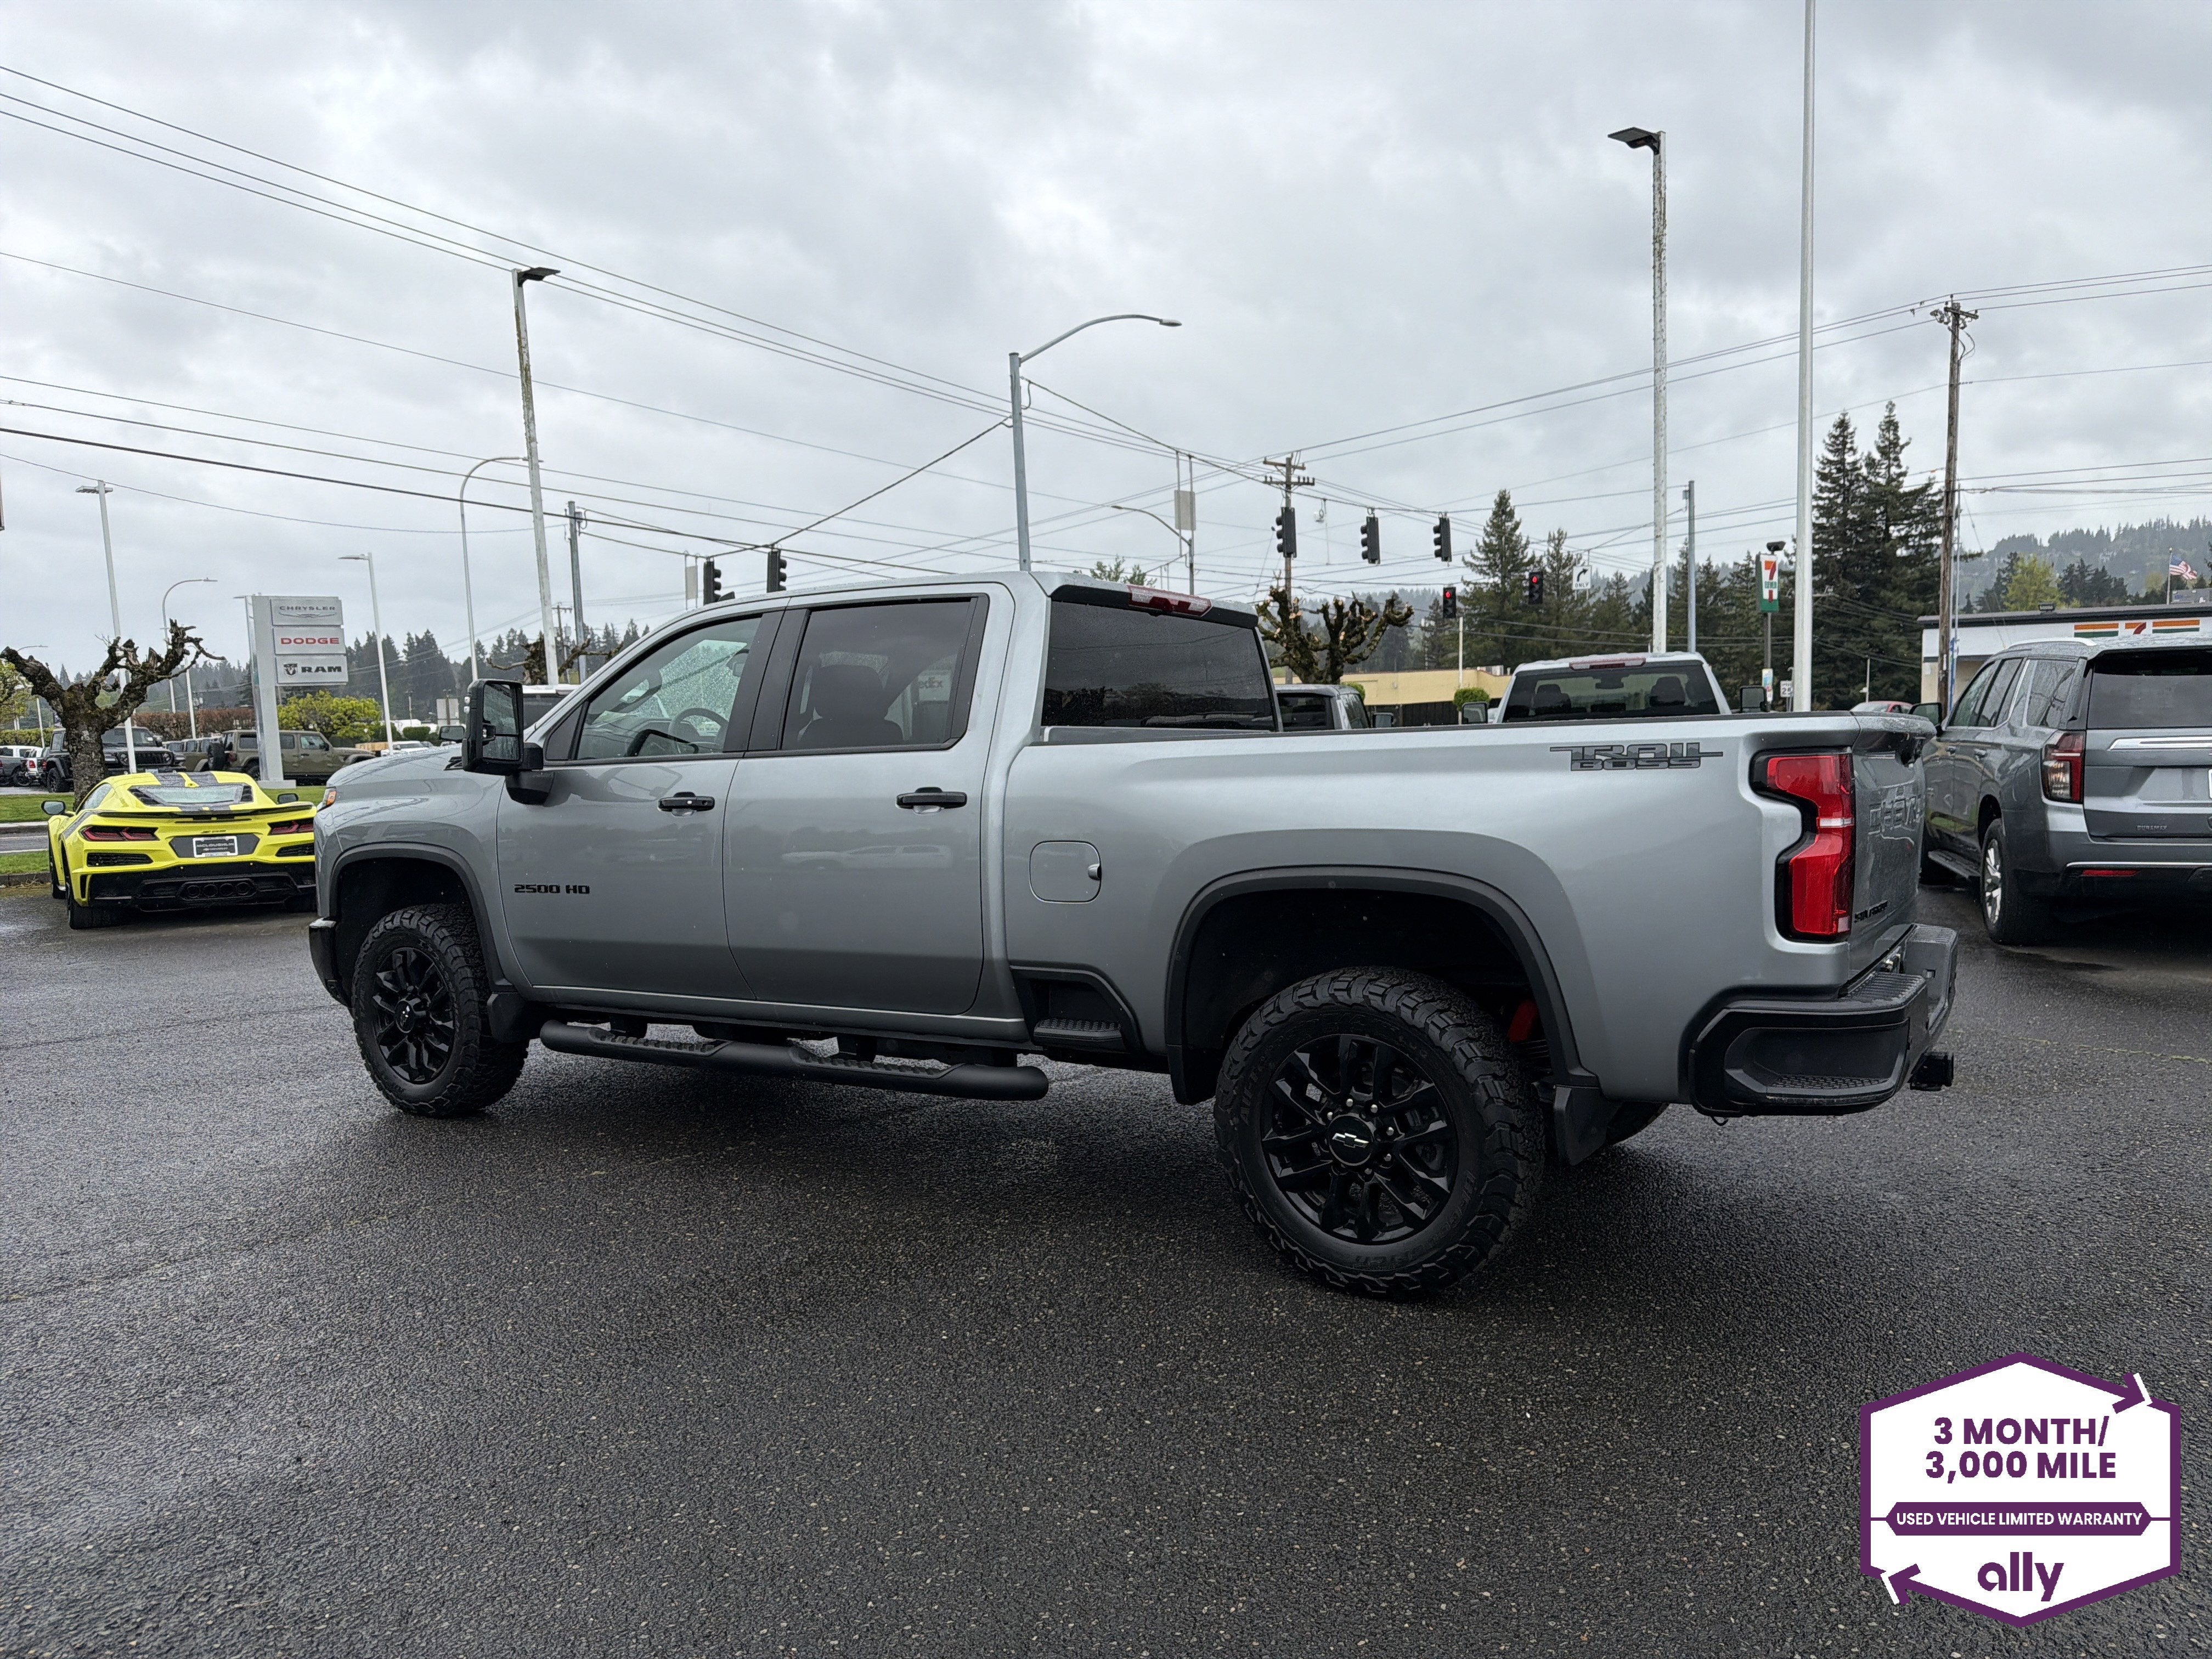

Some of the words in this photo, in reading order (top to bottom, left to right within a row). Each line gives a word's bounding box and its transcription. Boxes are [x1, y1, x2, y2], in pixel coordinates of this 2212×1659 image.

[1571, 756, 1701, 771] BOSS
[514, 884, 561, 894] 2500
[565, 884, 590, 894] HD
